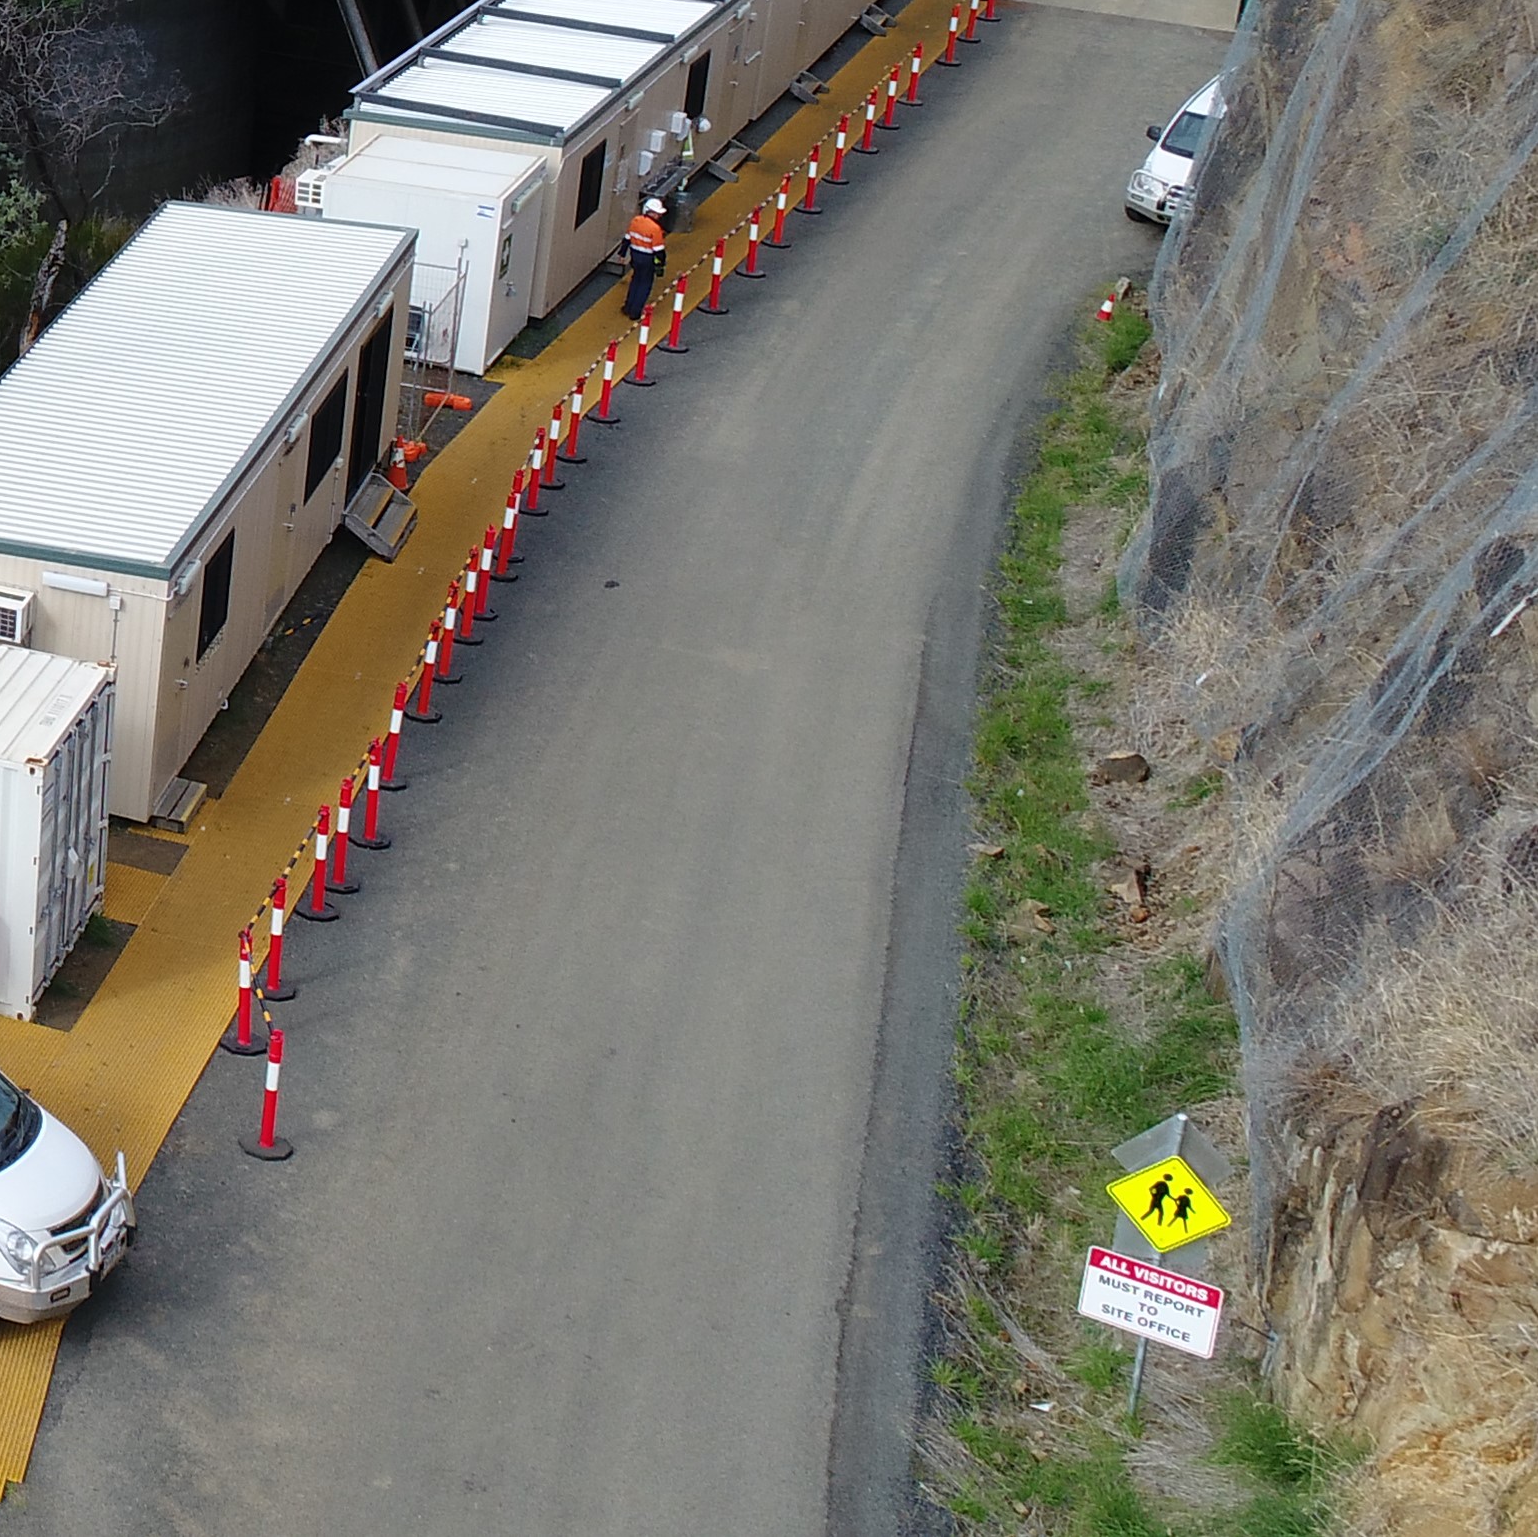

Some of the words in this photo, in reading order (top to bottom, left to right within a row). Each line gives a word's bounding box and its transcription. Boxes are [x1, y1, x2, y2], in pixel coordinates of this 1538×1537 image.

[1099, 1274, 1140, 1295] MUST
[1144, 1290, 1205, 1318] REPORT
[1100, 1255, 1131, 1275] ALL
[1134, 1266, 1208, 1301] VISITORS
[1101, 1304, 1133, 1322] SITE
[1137, 1317, 1191, 1342] OFFICE
[1138, 1302, 1158, 1316] TO
